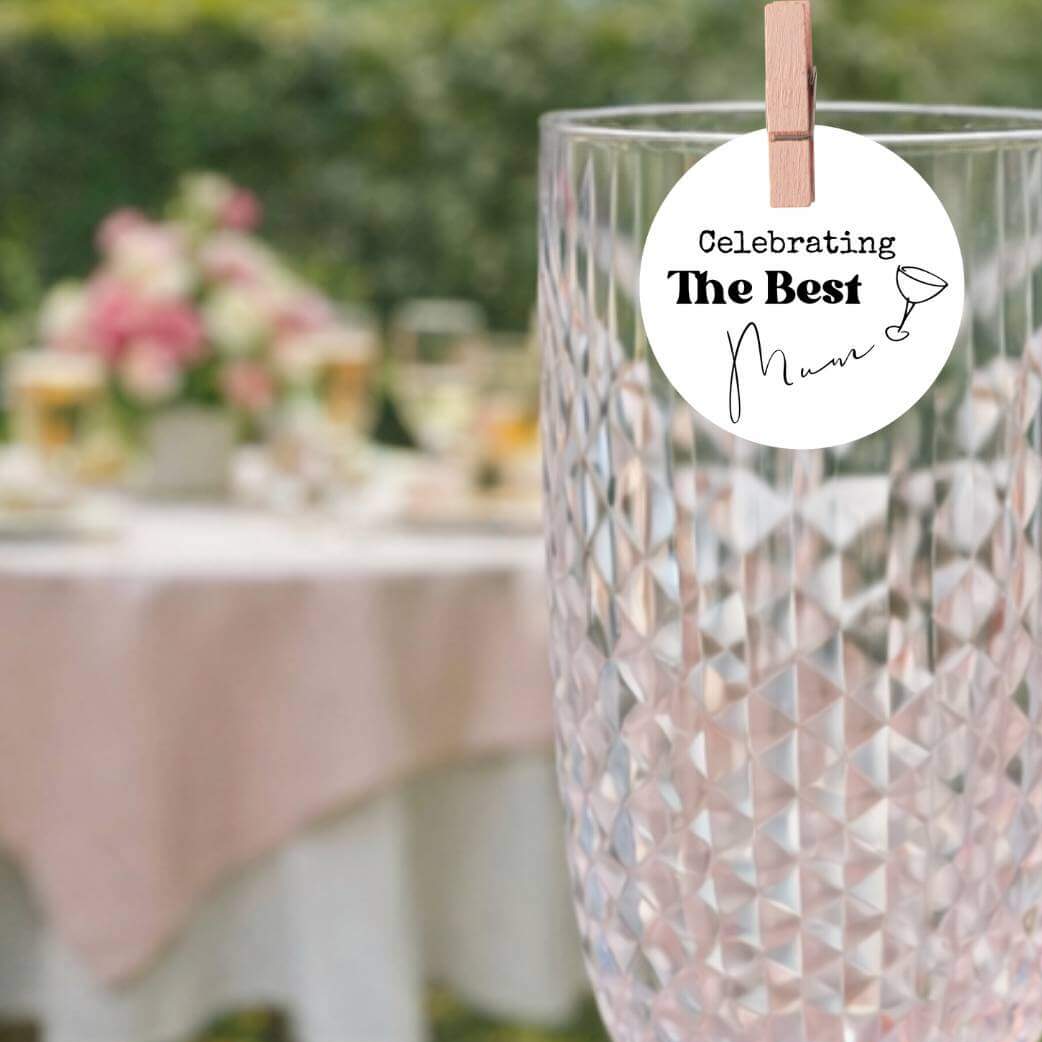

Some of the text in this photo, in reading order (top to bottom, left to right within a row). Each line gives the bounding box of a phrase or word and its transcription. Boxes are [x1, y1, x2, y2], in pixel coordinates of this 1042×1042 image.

[698, 229, 897, 261] Celebrating
[666, 270, 863, 305] The Best
[726, 321, 876, 424] Mum
